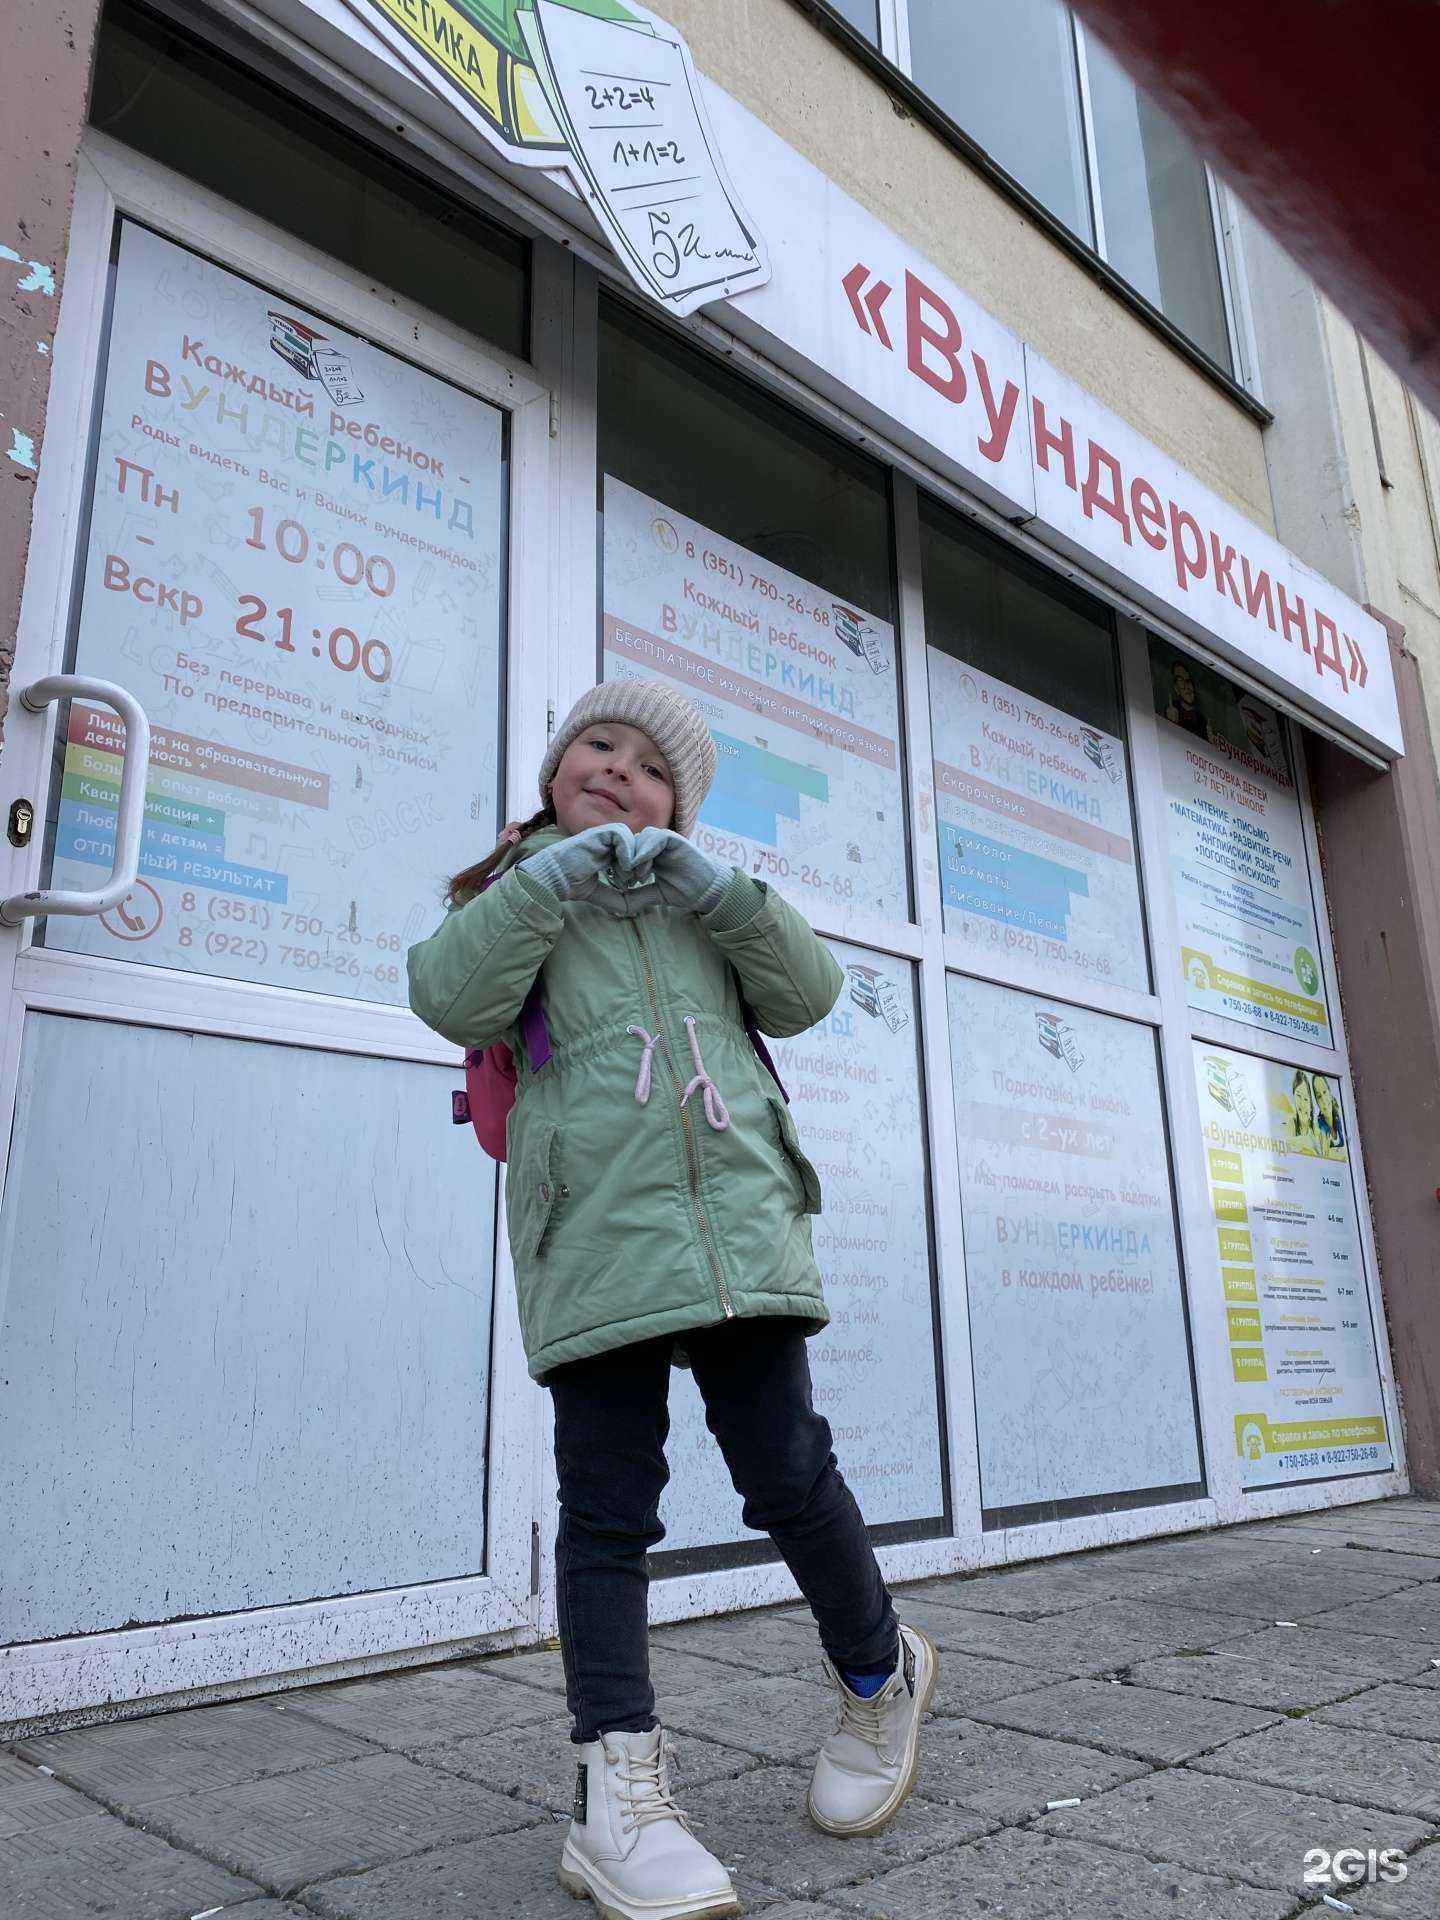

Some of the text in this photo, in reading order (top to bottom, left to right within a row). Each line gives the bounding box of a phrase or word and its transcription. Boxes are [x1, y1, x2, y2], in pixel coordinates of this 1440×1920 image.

[584, 86, 656, 111] 2+2=4
[181, 335, 313, 419] Каждый
[329, 410, 444, 479] ребенок
[131, 414, 181, 448] Рады
[189, 443, 250, 477] видеть
[258, 468, 288, 492] Вас
[296, 488, 307, 501] и
[315, 492, 369, 526] Ваших
[145, 359, 474, 539] ВУНДЕРКИНД
[114, 457, 179, 514] Пн
[841, 262, 1369, 694] «Вундеркинд»
[246, 505, 396, 599] 10:00
[103, 554, 204, 626] Вскр
[685, 540, 830, 627] 8 (351) 750-26-68
[235, 594, 393, 683] 21:00
[683, 578, 760, 634] Каждый
[768, 624, 838, 671] ребенок
[661, 603, 855, 719] ВУНДЕРКИНД
[176, 651, 431, 746] Без перерыва и выходных
[615, 627, 715, 684] БЕСПЛАТНОЕ
[719, 678, 777, 708] изучение
[782, 705, 855, 743] английского
[163, 673, 439, 773] По предварительной записи
[981, 689, 1080, 748] 8 (351) 750-26-68
[172, 738, 190, 752] на
[195, 745, 322, 789] образовательную
[982, 721, 1088, 784] Каждый ребенок
[1185, 749, 1241, 787] ПОДГОТОВКА
[161, 778, 201, 796] опыт
[942, 772, 1026, 817] Скорочтение
[969, 745, 1101, 823] ВУНДЕРКИНД
[1237, 791, 1266, 817] ШКОЛЕ
[161, 831, 208, 852] детям
[945, 826, 1013, 862] Психолог
[1174, 801, 1292, 869] МАТЕМАТИКА РАЗВИТИЕ РЕЧИ
[1198, 798, 1270, 843] ЧТЕНИЕ ПИСЬМО
[183, 861, 276, 892] РЕЗУЛЬТАТ
[752, 849, 853, 898] 750-26-68
[947, 855, 1013, 890] Шахматы
[1197, 843, 1281, 889] ЛОГОПЕД ПСИХОЛОГ
[1201, 831, 1277, 875] АНГЛИЙСКИЙ ЯЗЫК
[181, 891, 401, 953] 8 (351) 750-26-68
[178, 926, 400, 984] 8 (922) 750-26-68
[989, 924, 1111, 975] 8 (922) 750-26-68
[1228, 997, 1262, 1019] 750-26-68
[992, 1070, 1074, 1105] Подготовка
[1021, 1120, 1031, 1140] с
[1037, 1117, 1080, 1151] 2-ух
[974, 1165, 998, 1187] Мы
[1001, 1173, 1061, 1196] поможем
[1064, 1184, 1117, 1205] раскрыть
[849, 1203, 889, 1217] земли
[817, 1235, 888, 1254] огромного
[995, 1215, 1152, 1259] ВУНДЕРКИНДА
[842, 1273, 889, 1290] холить
[1002, 1268, 1155, 1300] в каждом ребёнке!
[836, 1310, 850, 1324] за
[1284, 1446, 1379, 1470] 750-26-68 8-922-750-26-68
